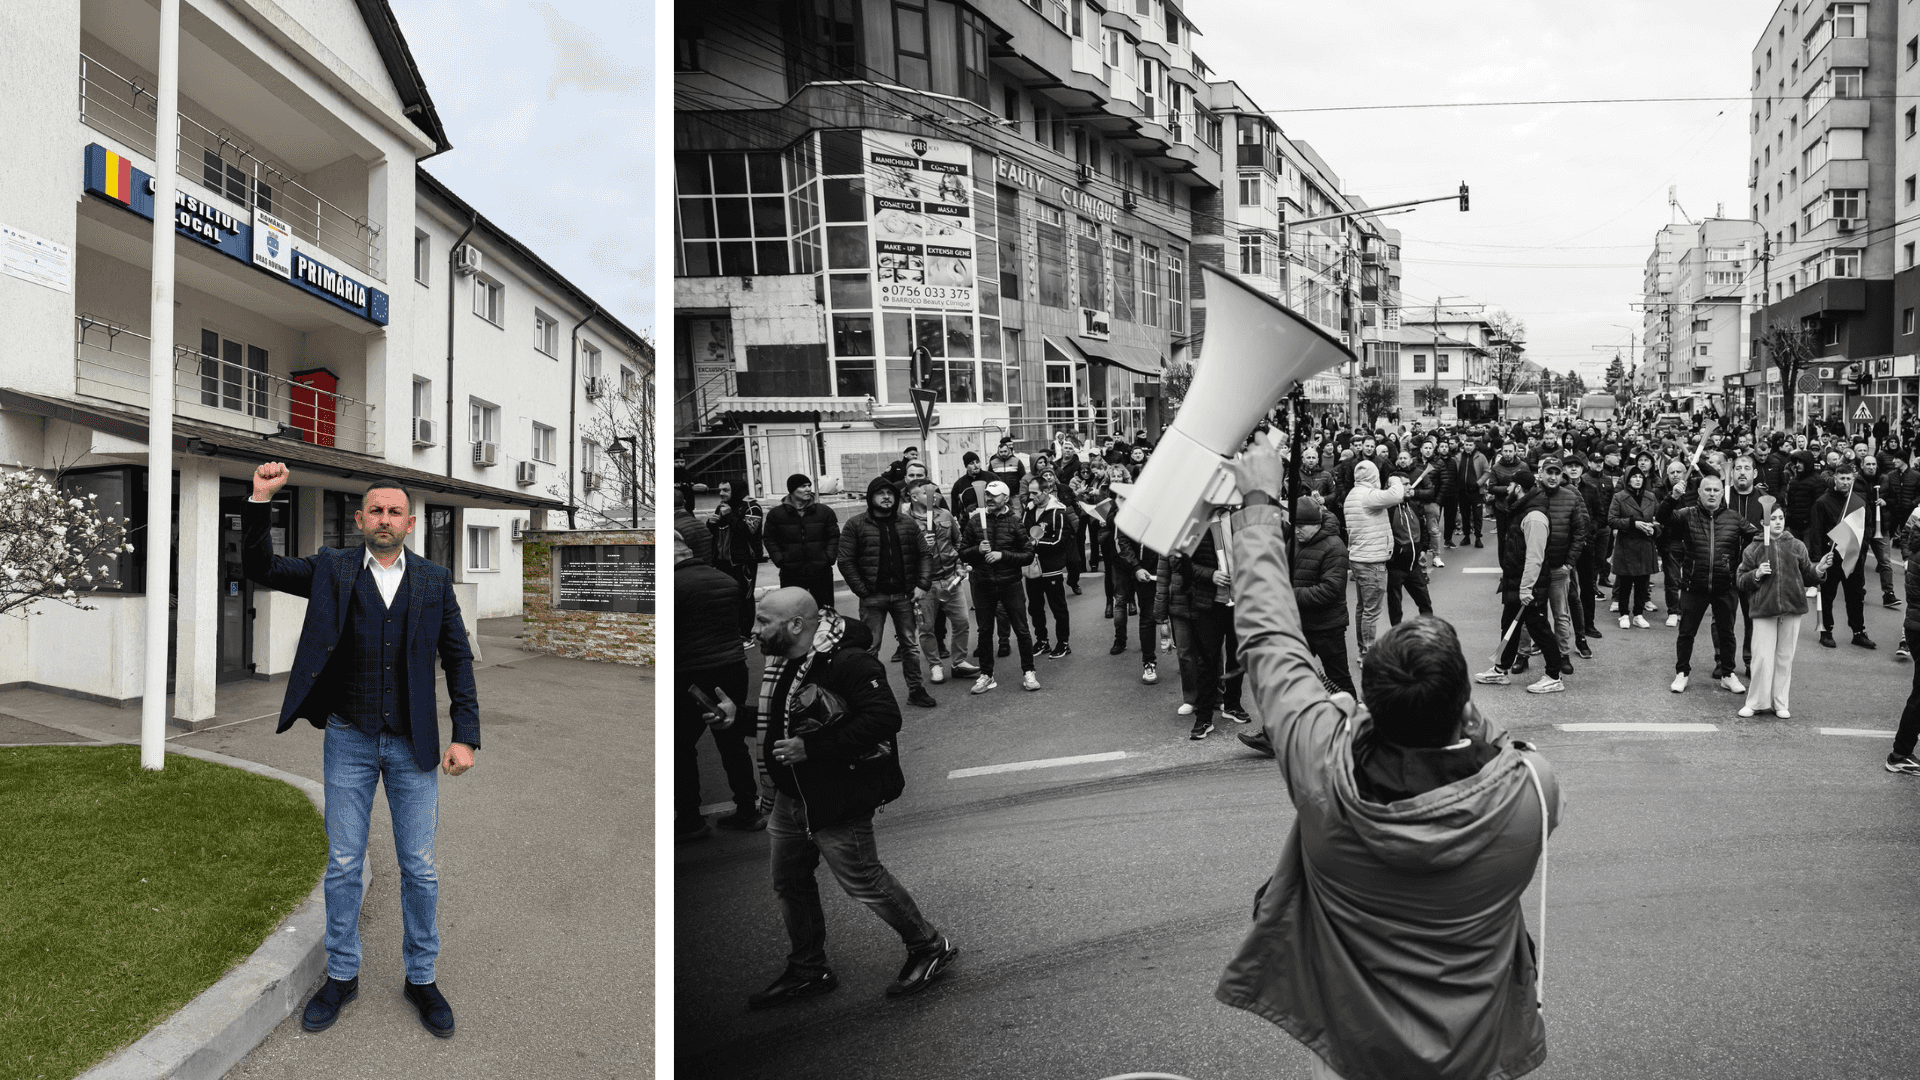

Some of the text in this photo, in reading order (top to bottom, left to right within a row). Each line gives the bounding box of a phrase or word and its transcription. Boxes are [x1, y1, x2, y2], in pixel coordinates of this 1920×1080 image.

[149, 177, 240, 234] CNSILIUL
[937, 206, 958, 214] MASAJ
[1061, 186, 1118, 225] CLINIQUE
[175, 211, 223, 243] OCAL
[883, 244, 902, 252] MAKE
[927, 247, 971, 257] EXTENSII GENE
[891, 285, 970, 300] 0756 033 375
[891, 297, 971, 307] BARROCO Beauty Clinique
